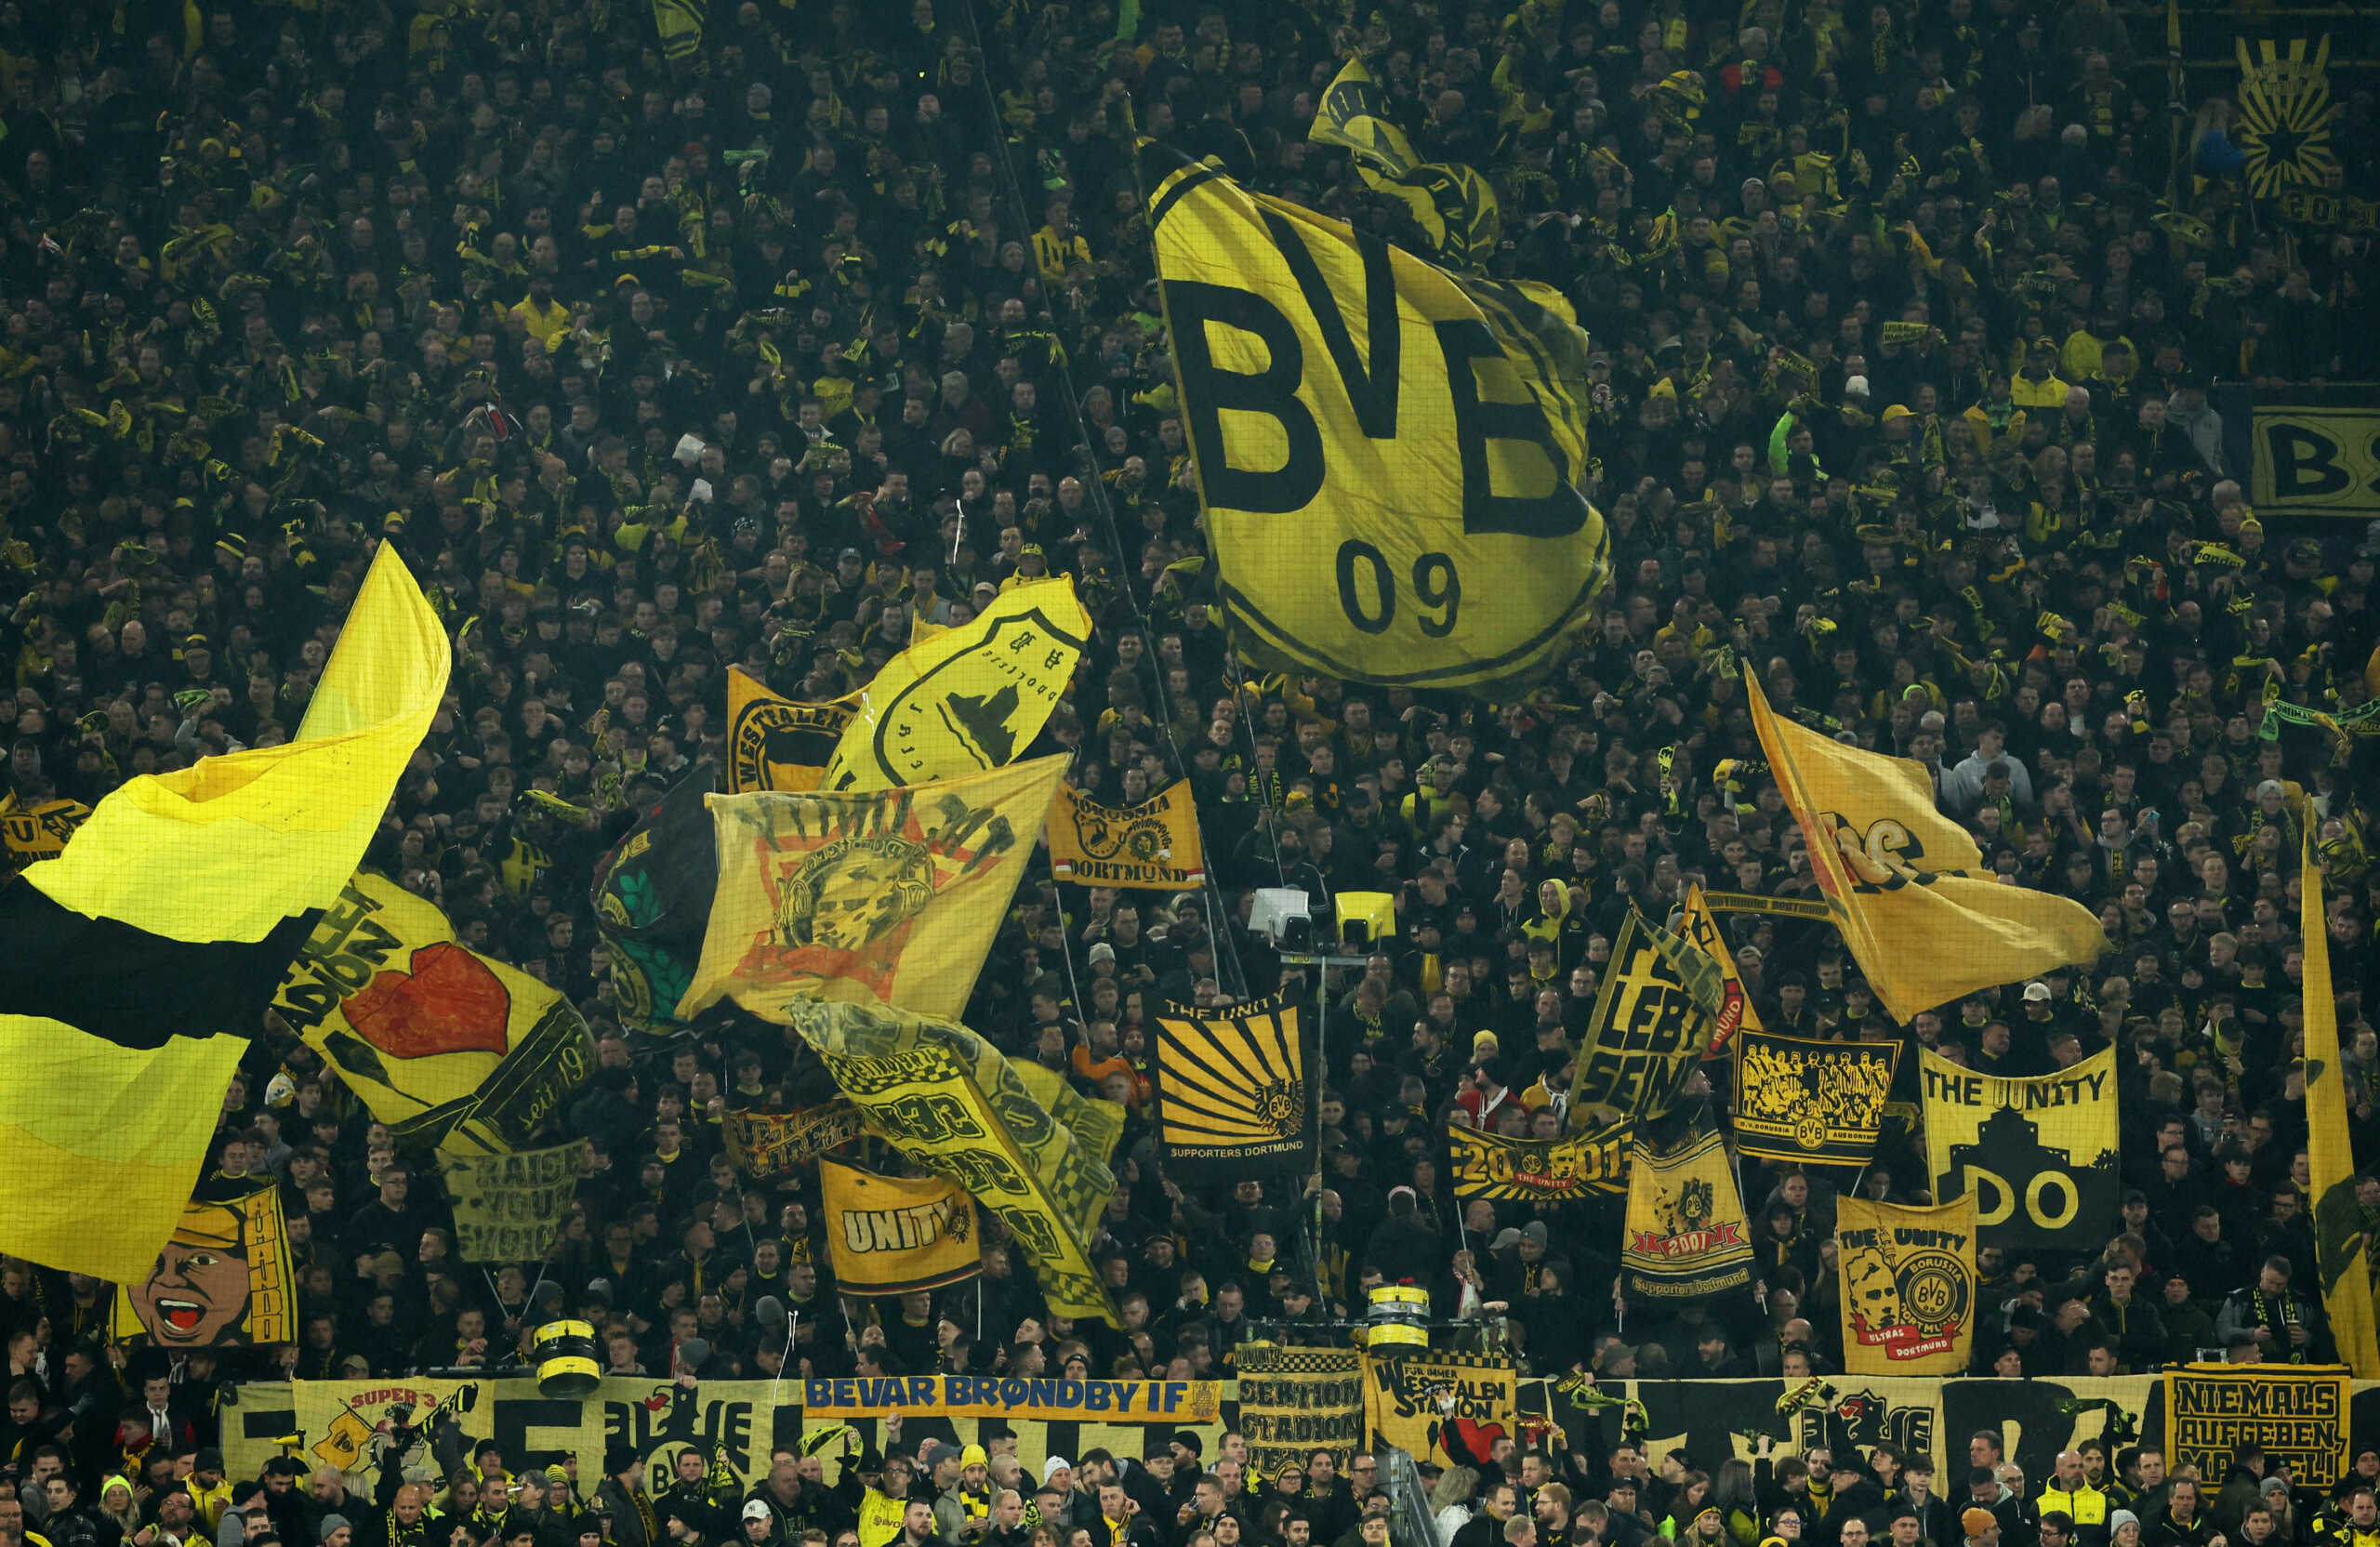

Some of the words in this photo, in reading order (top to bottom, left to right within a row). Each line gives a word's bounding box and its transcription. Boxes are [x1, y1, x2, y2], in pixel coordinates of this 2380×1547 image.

[1335, 538, 1462, 637] 09
[1070, 858, 1188, 882] DORTMUND
[1165, 998, 1211, 1020] THE
[1220, 987, 1286, 1020] UNITY
[518, 1085, 555, 1130] seit
[558, 1034, 585, 1084] 19
[1924, 1067, 1982, 1106] THE
[1270, 1096, 1292, 1113] BVB
[1800, 1121, 1823, 1140] BVB
[1170, 1147, 1242, 1158] SUPPORTERS
[1245, 1140, 1303, 1157] DORTMUND
[1461, 1142, 1513, 1182] 20
[1517, 1173, 1536, 1185] THE
[1538, 1176, 1568, 1189] UNITY
[1964, 1164, 2079, 1229] DO
[842, 1193, 956, 1254] UNITY
[1667, 1234, 1707, 1256] 2001
[1840, 1228, 1878, 1250] THE
[1894, 1228, 1967, 1252] UNITY
[1695, 1268, 1750, 1293] Dortmund
[1909, 1257, 1963, 1283] BORUSSIA
[1918, 1277, 1947, 1307] BVB
[1869, 1329, 1905, 1342] ULTRAS
[1897, 1340, 1948, 1357] DORTMUND
[1404, 1366, 1424, 1376] FÜR
[1426, 1368, 1458, 1379] IMMER
[350, 1388, 417, 1409] SUPER
[423, 1393, 438, 1408] 3
[804, 1377, 938, 1408] BEVAR
[945, 1377, 1140, 1413] BRØNDBY
[1147, 1382, 1188, 1413] IF
[1239, 1377, 1364, 1408] SEKTION
[2176, 1380, 2338, 1419] NIEMALS
[1394, 1394, 1493, 1419] STAION
[1241, 1411, 1362, 1443] STADION
[2177, 1448, 2336, 1487] MAEL!
